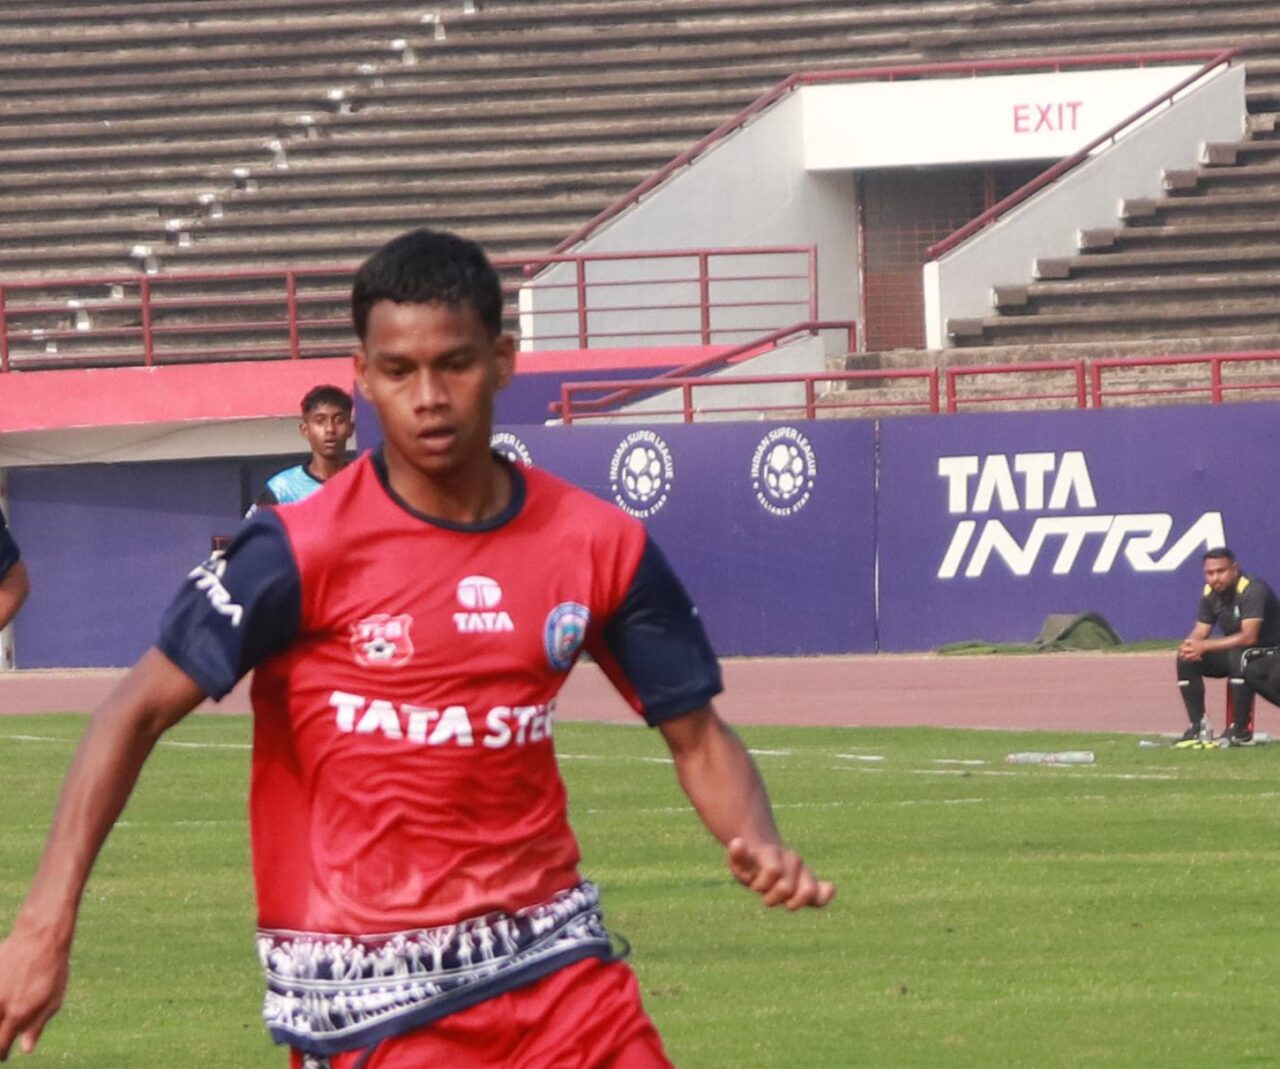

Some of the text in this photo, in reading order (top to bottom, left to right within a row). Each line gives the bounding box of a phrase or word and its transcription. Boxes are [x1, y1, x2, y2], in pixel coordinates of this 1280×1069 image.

[1013, 101, 1083, 133] EXIT
[609, 430, 674, 480] INDIAN SUPER LEAGUE
[751, 426, 817, 478] INDIAN SUPER LEAGUE
[937, 451, 1097, 514] TATA
[937, 512, 1226, 579] INTRA
[453, 612, 514, 632] TATA
[328, 690, 474, 747] TATA
